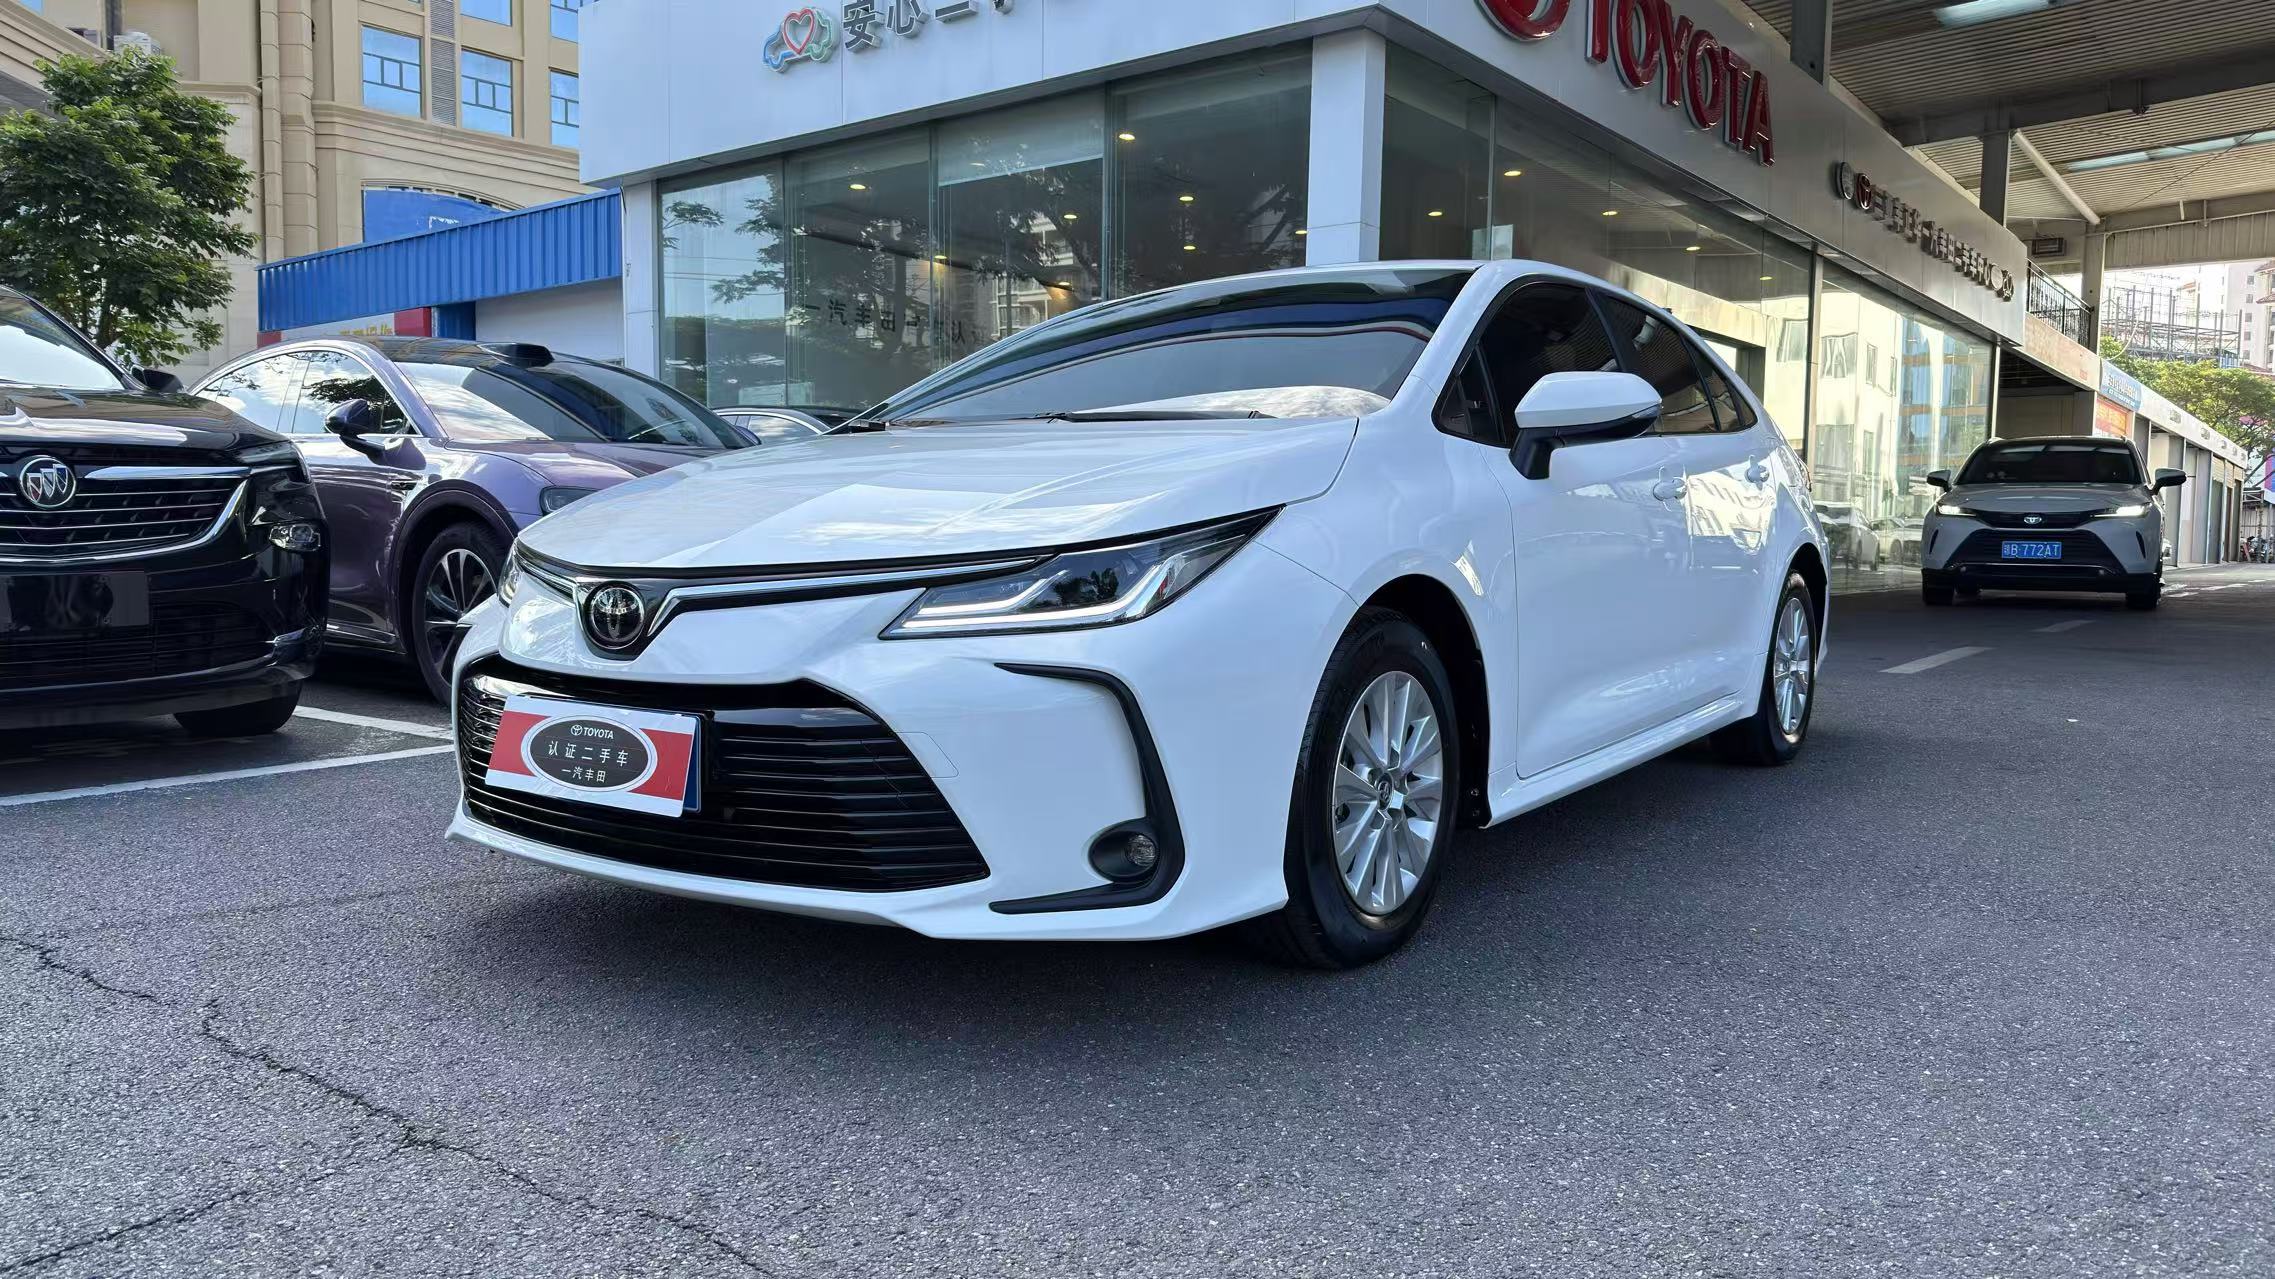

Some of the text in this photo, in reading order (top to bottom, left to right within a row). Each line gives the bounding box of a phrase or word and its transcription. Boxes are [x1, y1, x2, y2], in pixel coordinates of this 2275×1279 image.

[843, 0, 1010, 49] 安心
[584, 727, 614, 740] TOYOTA
[548, 740, 629, 767] 认证二手车
[561, 766, 606, 783] 一汽丰田
